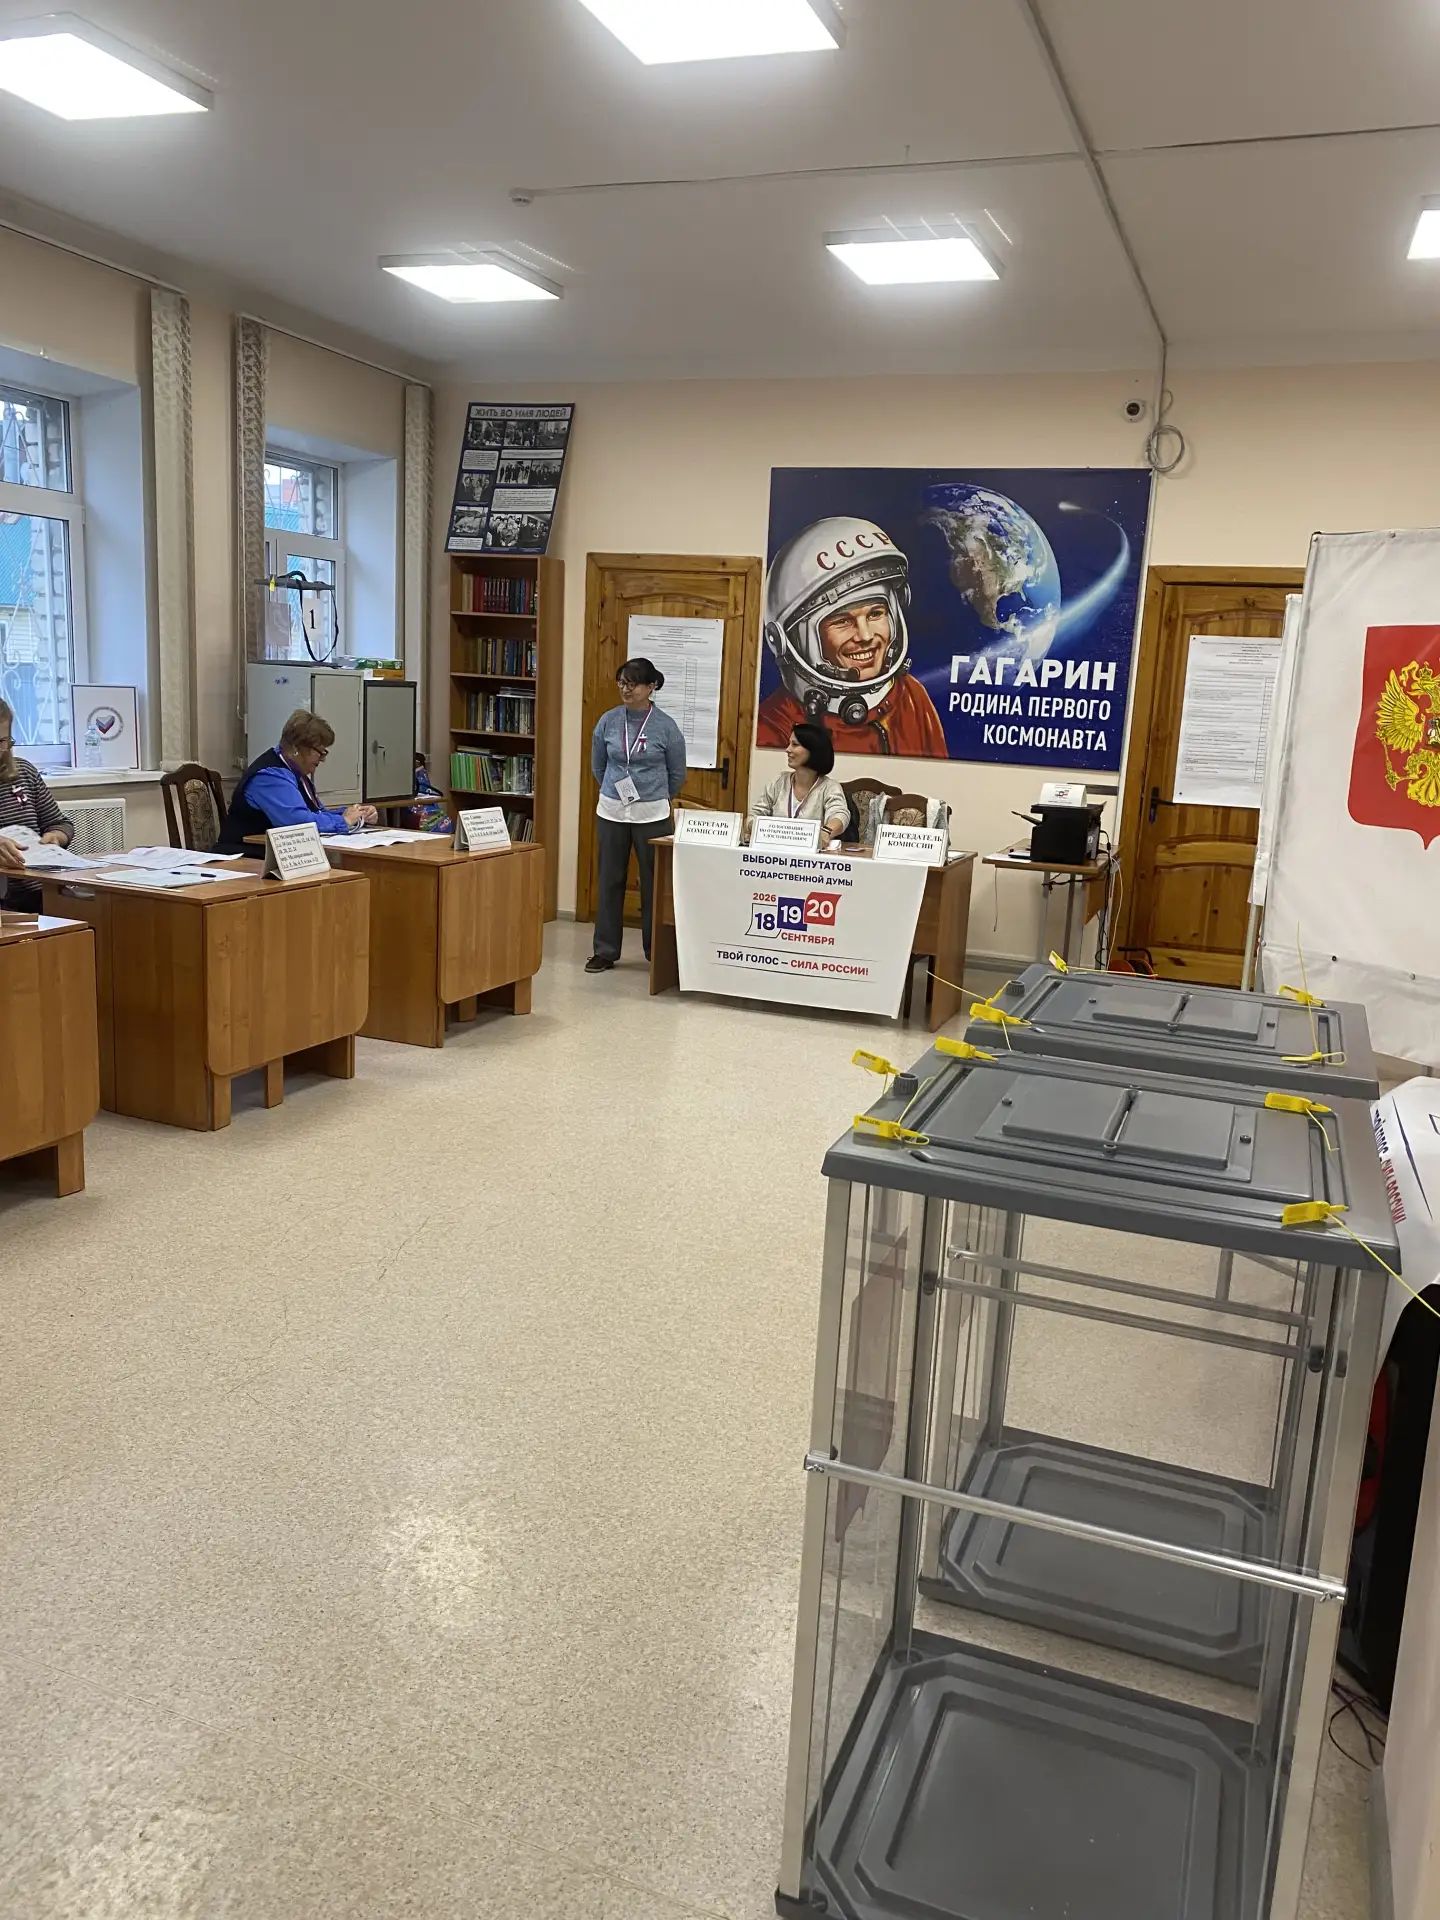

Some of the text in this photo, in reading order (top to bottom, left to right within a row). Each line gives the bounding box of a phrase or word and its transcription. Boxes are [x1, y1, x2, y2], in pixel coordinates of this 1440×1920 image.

[475, 408, 567, 417] ЖИТЬ ВО ИМЯ ЛЮДЕЙ
[816, 532, 890, 570] СССР
[309, 609, 316, 629] 1
[950, 655, 1117, 691] ГАГАРИН
[949, 692, 1111, 721] РОДИНА ПЕРВОГО
[983, 724, 1107, 751] КОСМОНАВТА
[686, 828, 728, 836] КОМИССИИ
[688, 820, 729, 828] СЕКРЕТАРЬ
[881, 831, 942, 842] ПРЕДСЕДАТЕЛЬ
[887, 840, 933, 849] КОМИССИИ
[742, 854, 851, 871] ВЫБОРЫ ДЕПУТАТОВ
[739, 869, 853, 887] ГОСУДАРСТВЕННОЙ ДУМЫ
[752, 892, 777, 902] 2026
[754, 899, 834, 930] 18 19 20
[781, 932, 835, 946] СЕНТЯБРЯ
[716, 950, 743, 962] ТВОЙ
[745, 953, 779, 965] ГОЛОС
[790, 959, 819, 970] СИЛА
[821, 963, 869, 976] РОССИИ!
